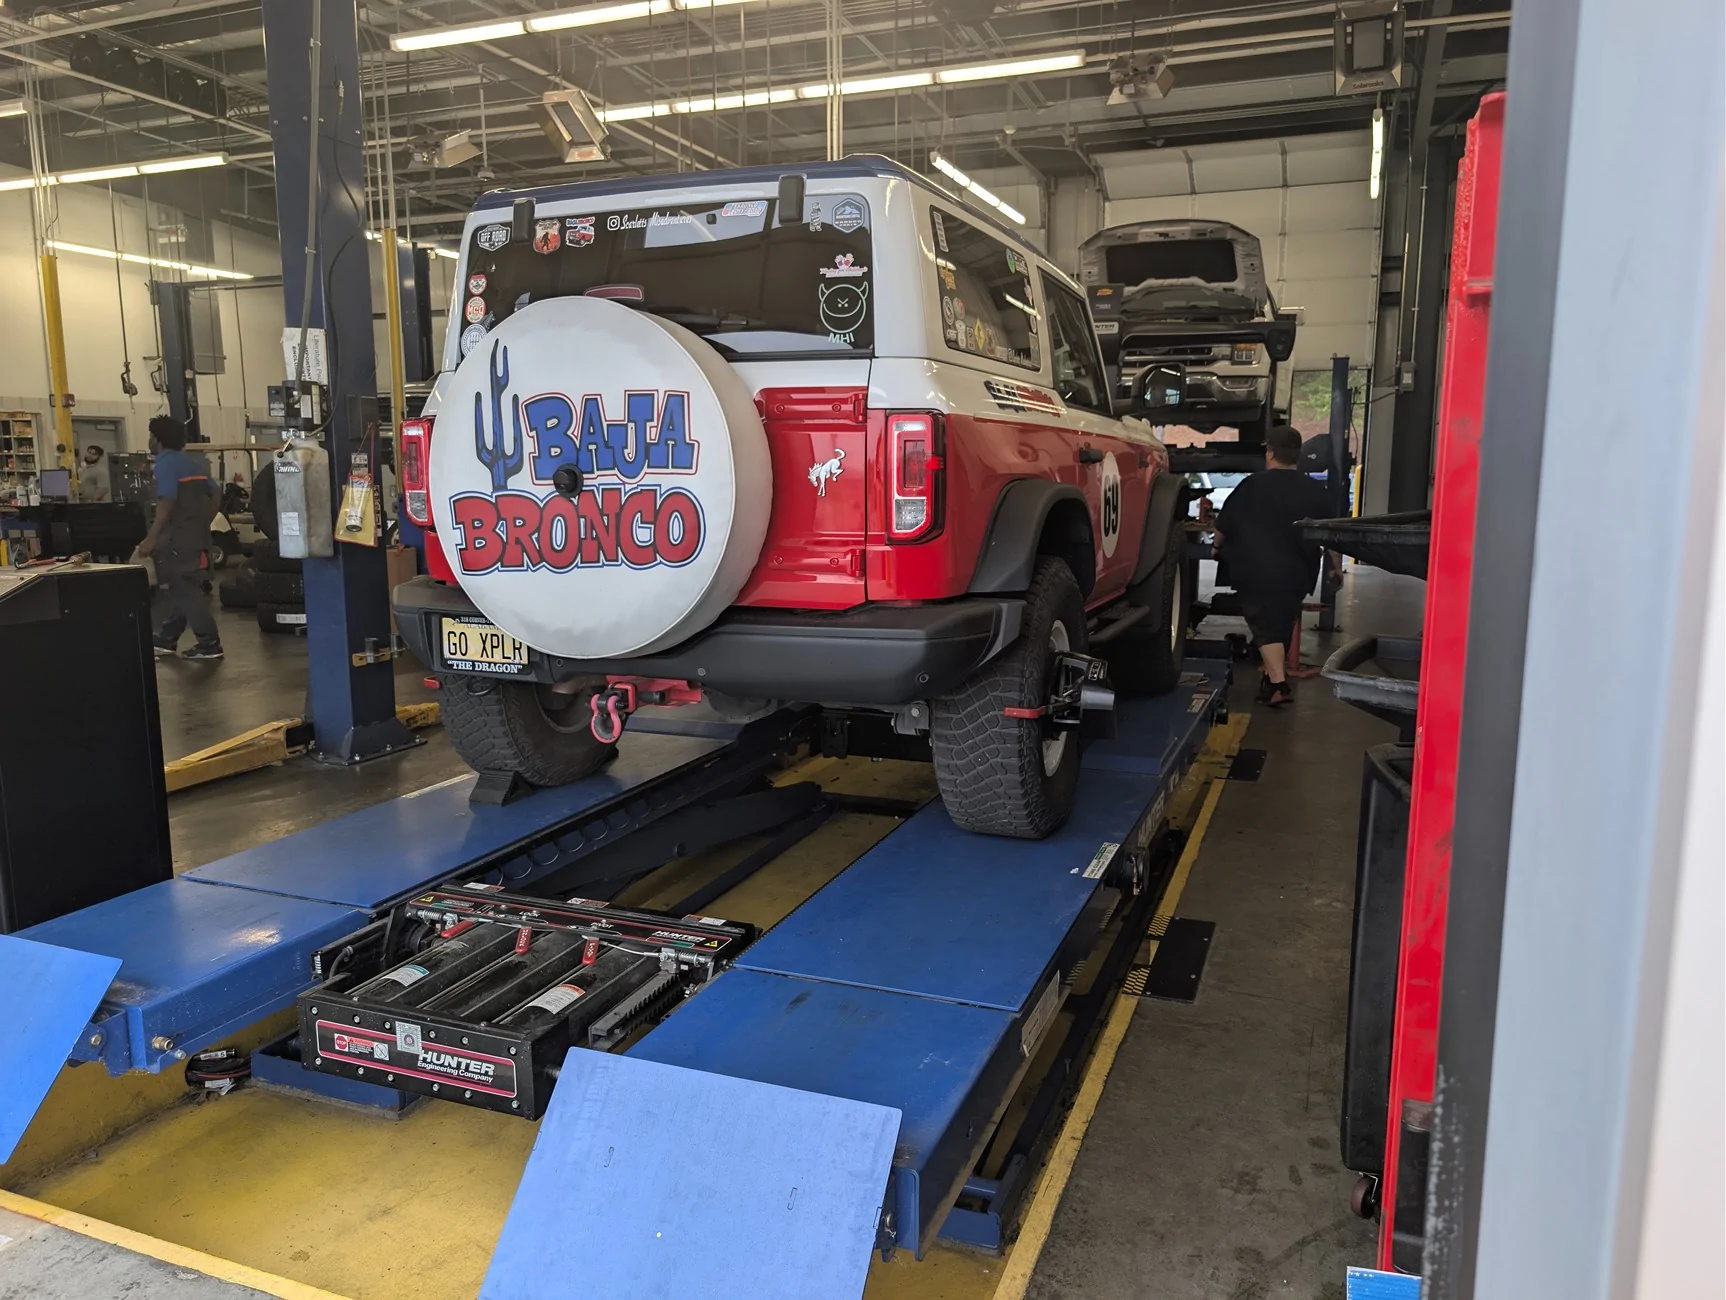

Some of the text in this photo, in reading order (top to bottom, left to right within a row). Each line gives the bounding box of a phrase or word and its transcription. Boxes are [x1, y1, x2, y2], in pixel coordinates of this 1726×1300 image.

[480, 232, 491, 242] OFF
[828, 332, 854, 344] MHI
[522, 390, 699, 485] BAJA
[1103, 474, 1118, 537] 69
[451, 485, 704, 574] BRONCO
[447, 631, 522, 660] GO XPLR
[652, 930, 707, 943] HUNTER
[417, 1061, 494, 1083] Engineering Company
[418, 1050, 496, 1076] HUNTER
